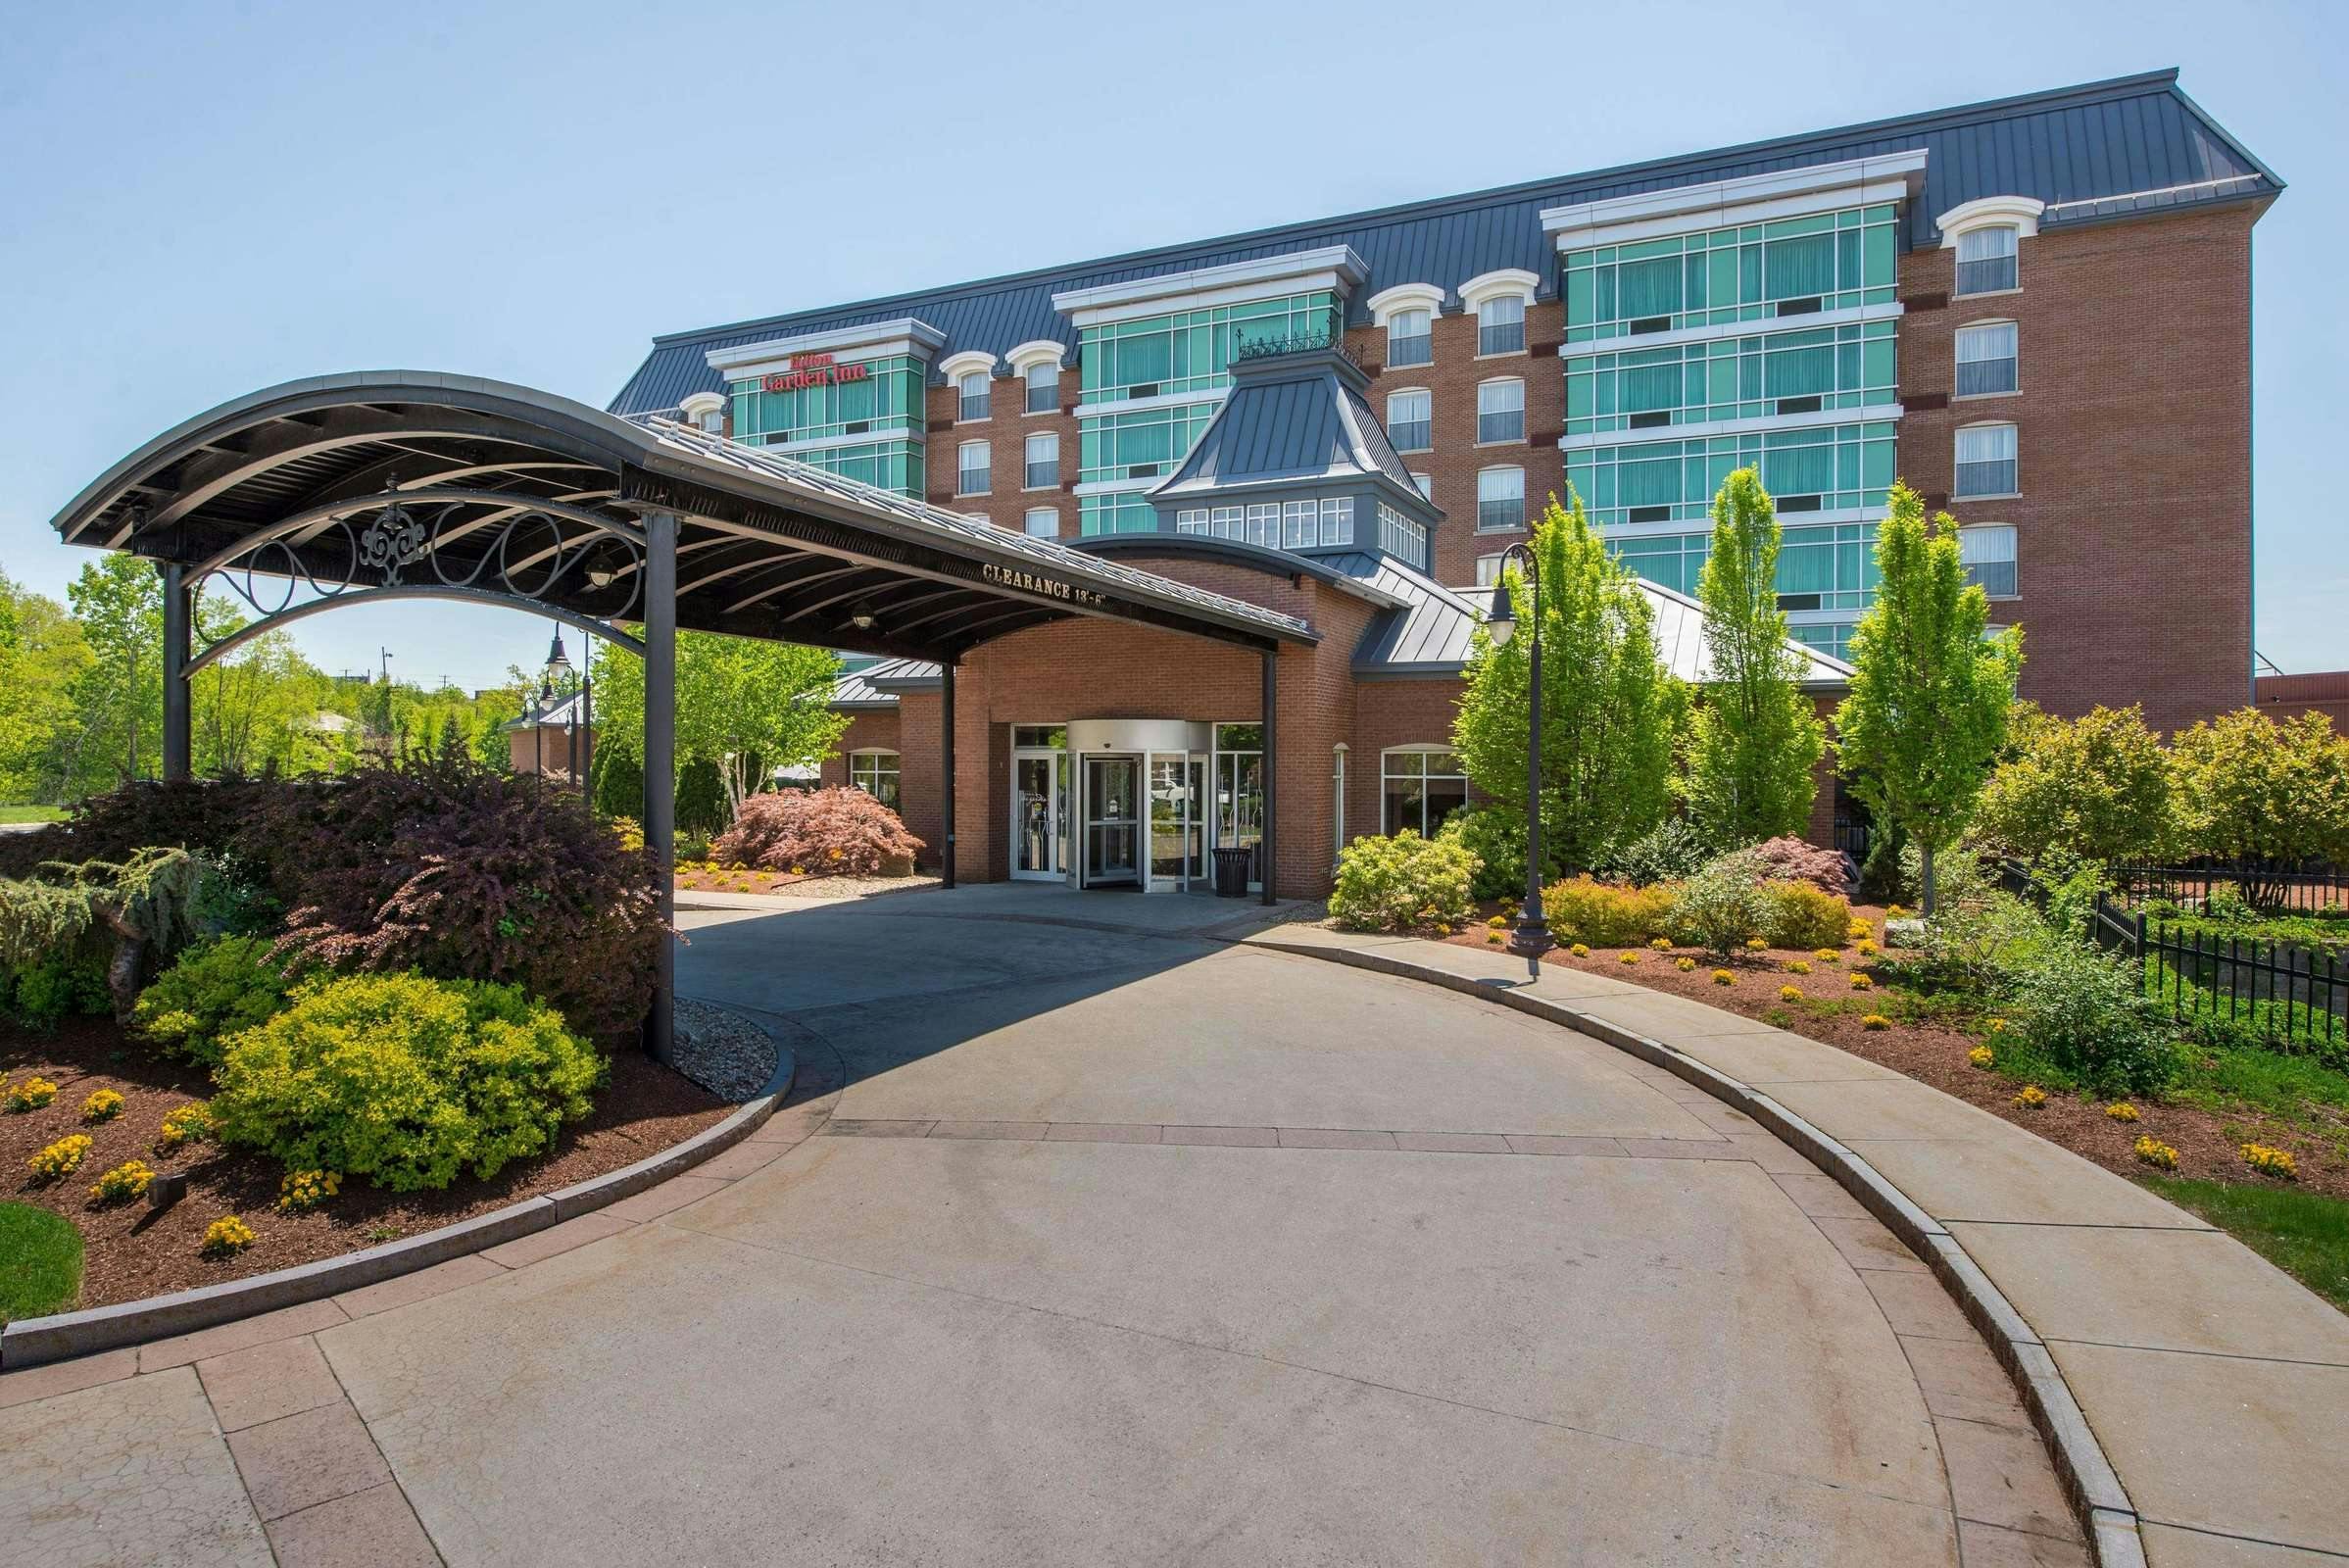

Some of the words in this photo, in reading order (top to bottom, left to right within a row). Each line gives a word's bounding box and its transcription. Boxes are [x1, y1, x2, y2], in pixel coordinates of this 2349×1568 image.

[789, 354, 832, 369] Hilton
[760, 368, 827, 392] Garden
[832, 364, 867, 383] Inn
[982, 564, 1070, 599] CLEARANCE
